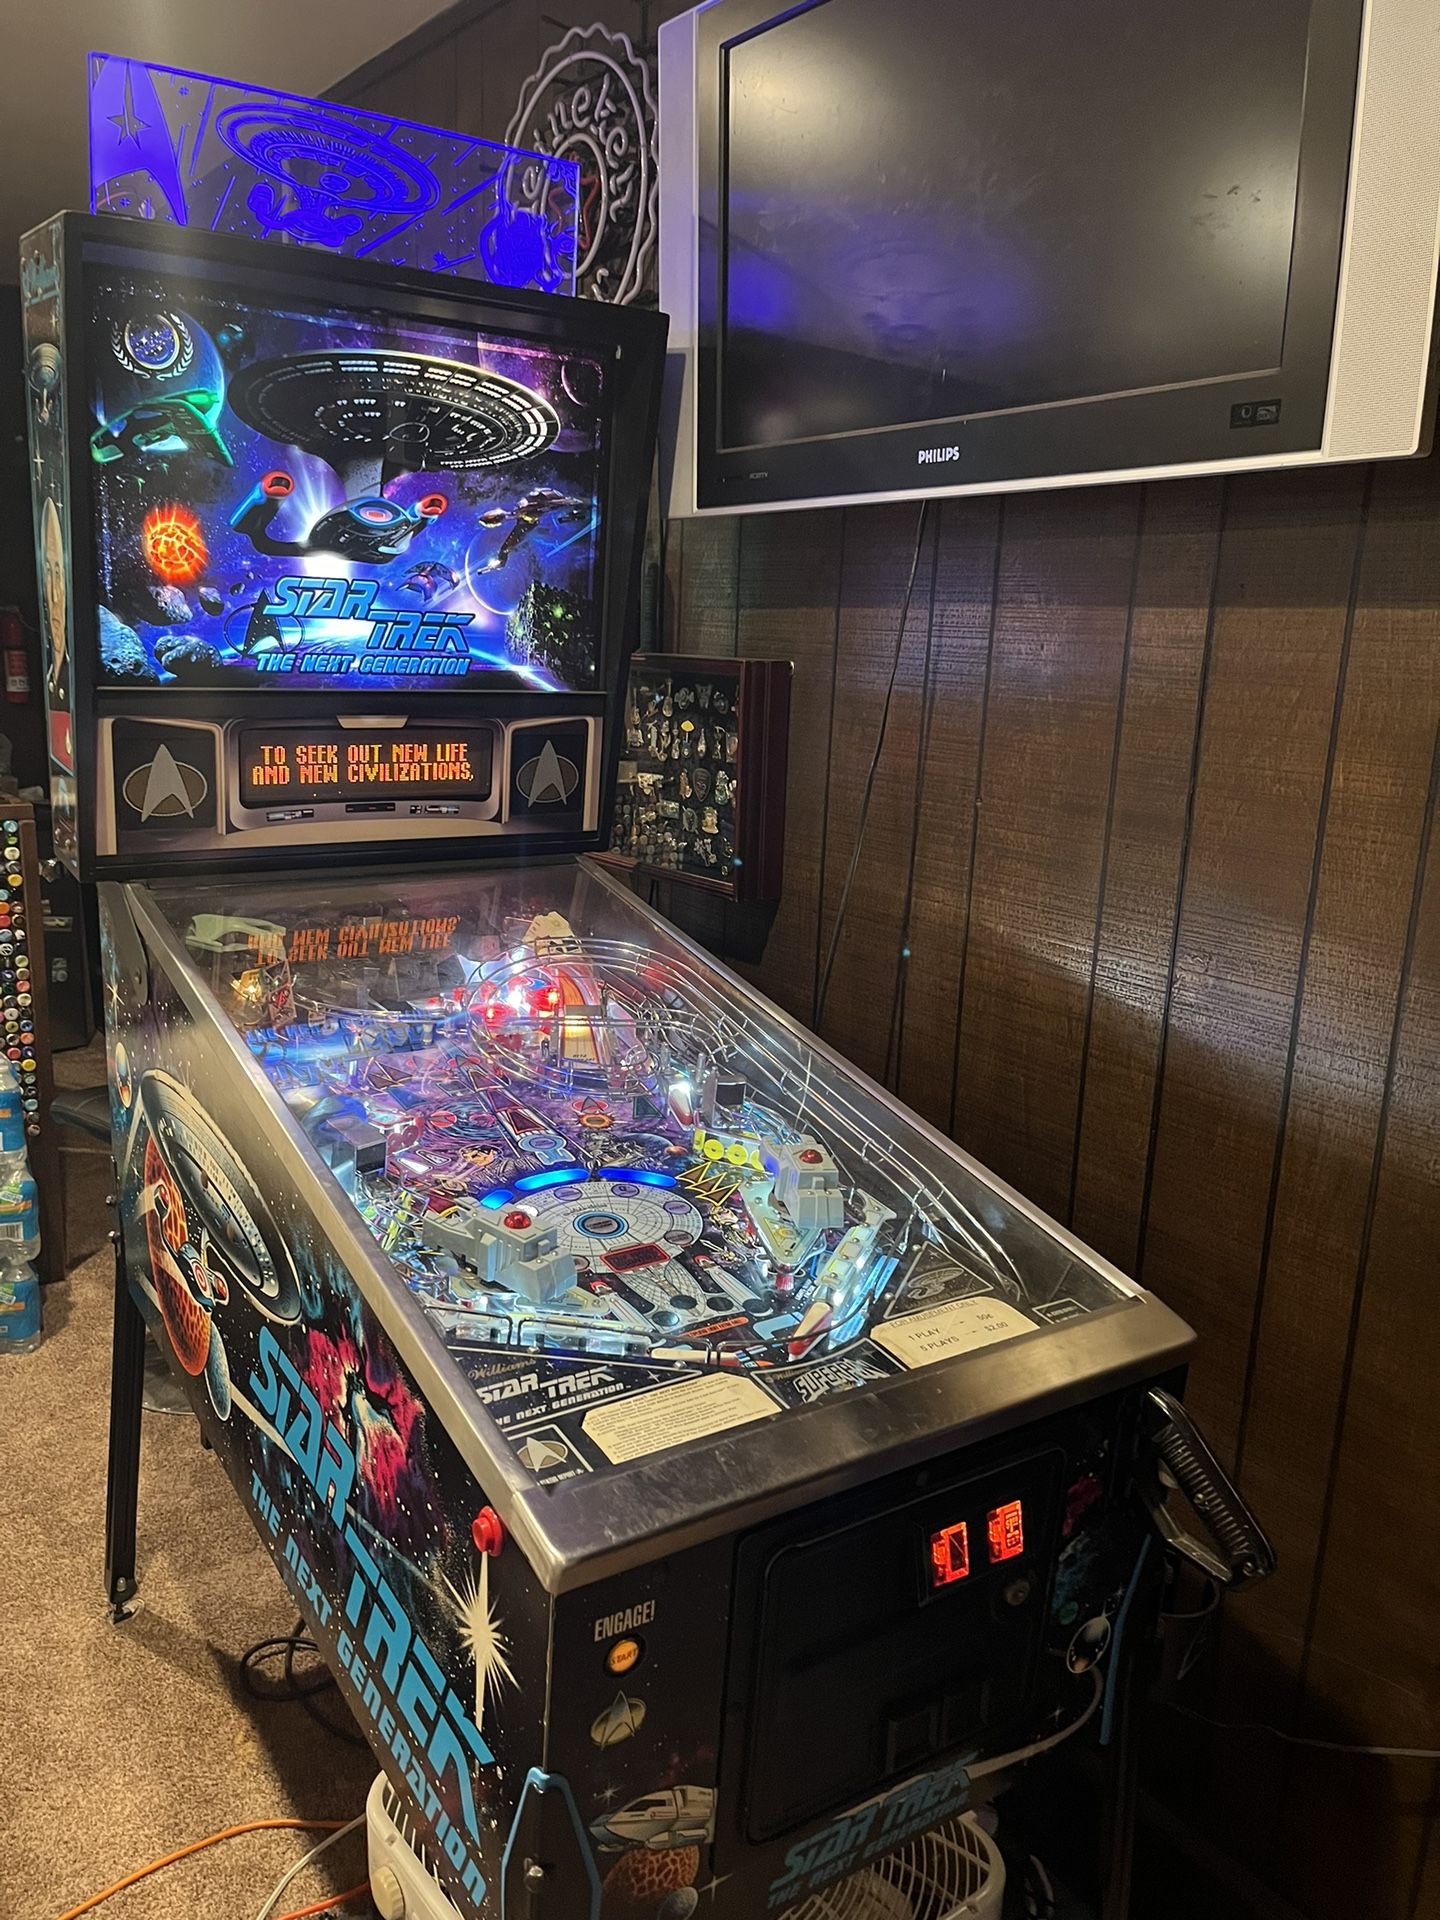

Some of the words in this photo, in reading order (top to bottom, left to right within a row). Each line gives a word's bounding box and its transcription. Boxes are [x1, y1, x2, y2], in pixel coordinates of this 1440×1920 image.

[917, 446, 960, 464] PHILIPS
[263, 576, 379, 618] STAR
[367, 611, 475, 651] TREK
[257, 653, 296, 672] THE
[301, 655, 353, 673] NEXT
[358, 656, 471, 675] GENERATION
[260, 745, 286, 765] TO
[296, 744, 338, 765] SEEK
[347, 744, 382, 763] OUT
[391, 743, 428, 763] NEW
[436, 743, 468, 762] LIFE
[252, 765, 290, 785] AND
[299, 764, 338, 784] NEW
[347, 761, 475, 784] CIVILIZATIONS,
[916, 1326, 941, 1340] PLAY
[928, 1335, 960, 1350] PLAYS
[468, 1357, 537, 1381] Williams
[475, 1372, 539, 1405] STAR
[539, 1366, 615, 1399] TREK
[515, 1404, 548, 1423] NEXT
[552, 1383, 625, 1411] GENERATION
[250, 1326, 356, 1530] STAR
[344, 1521, 496, 1849] TREK
[594, 1600, 656, 1642] ENGAGE!
[609, 1648, 638, 1666] START
[250, 1469, 281, 1538] THE
[283, 1533, 333, 1628] NEXT
[336, 1629, 487, 1907] GENERATION
